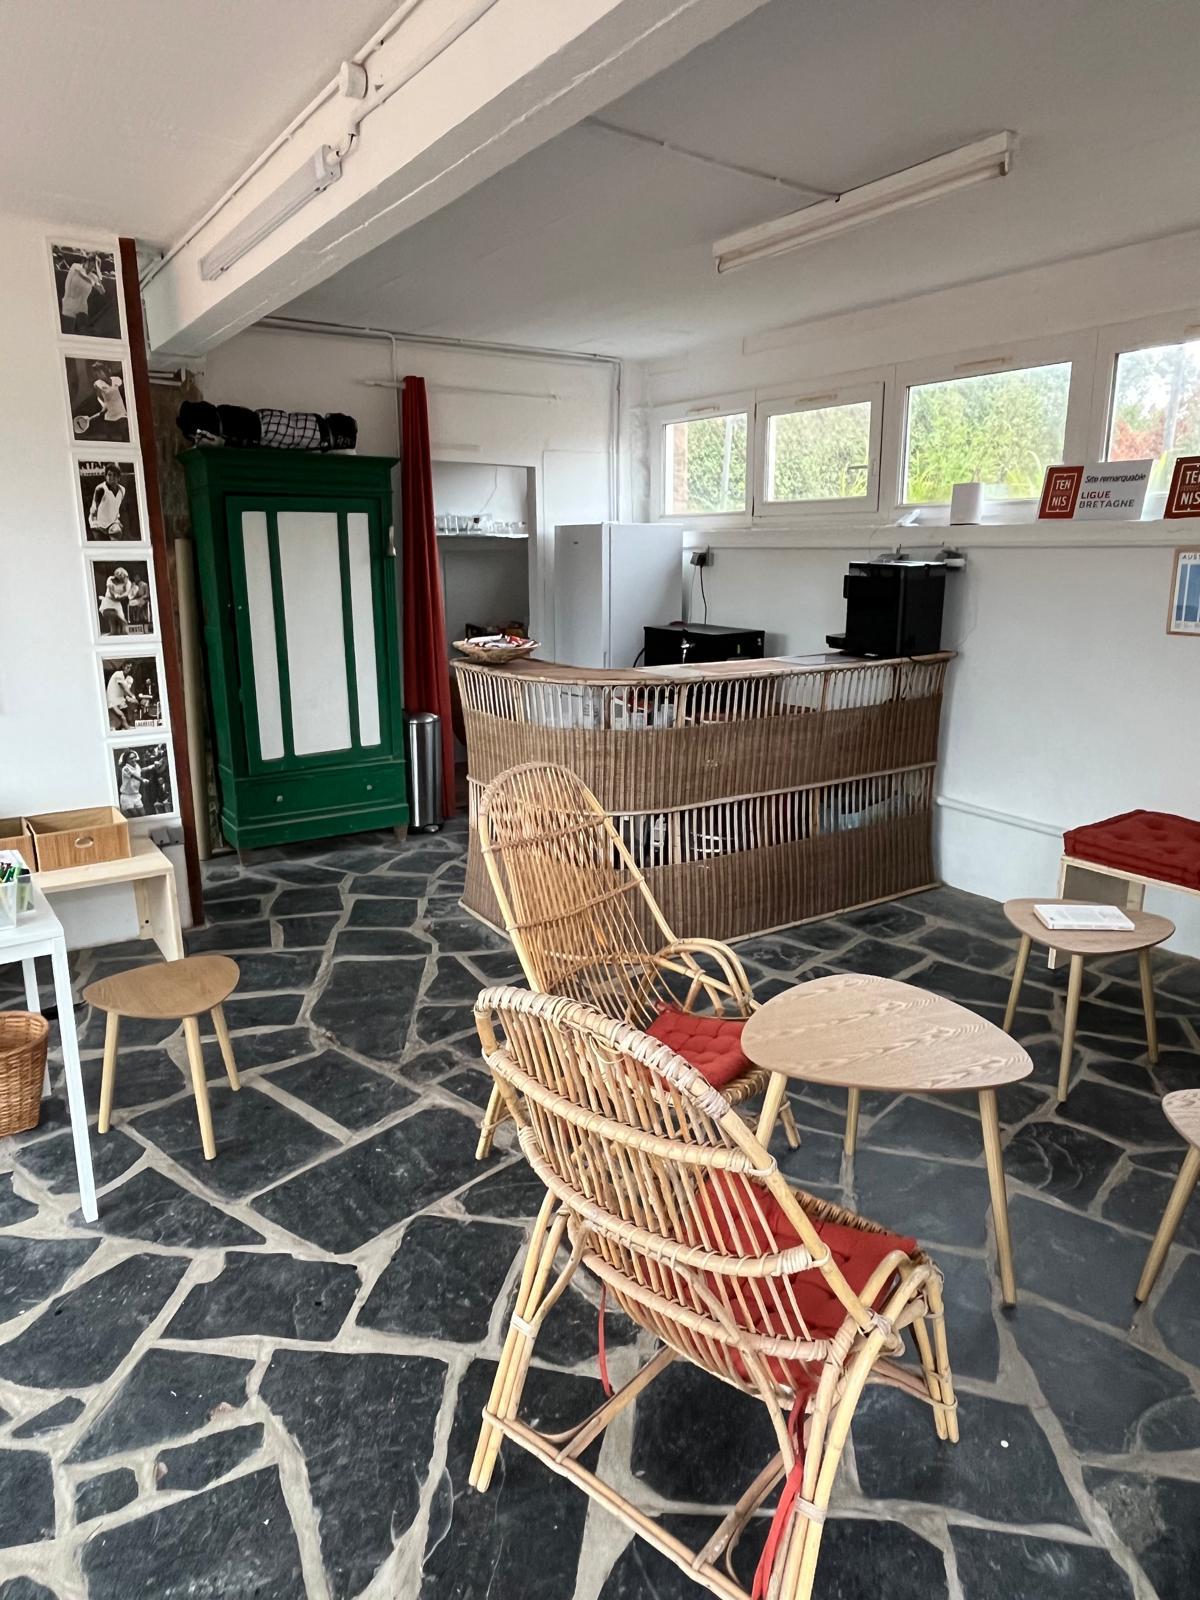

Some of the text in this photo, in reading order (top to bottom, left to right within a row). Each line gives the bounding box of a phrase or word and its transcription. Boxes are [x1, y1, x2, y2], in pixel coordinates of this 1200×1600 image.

[1085, 473, 1147, 484] Site remarquable
[1055, 479, 1072, 490] TEN
[1080, 490, 1111, 499] LIGUE
[1051, 496, 1068, 507] NIS
[1078, 499, 1135, 509] BRETAGNE
